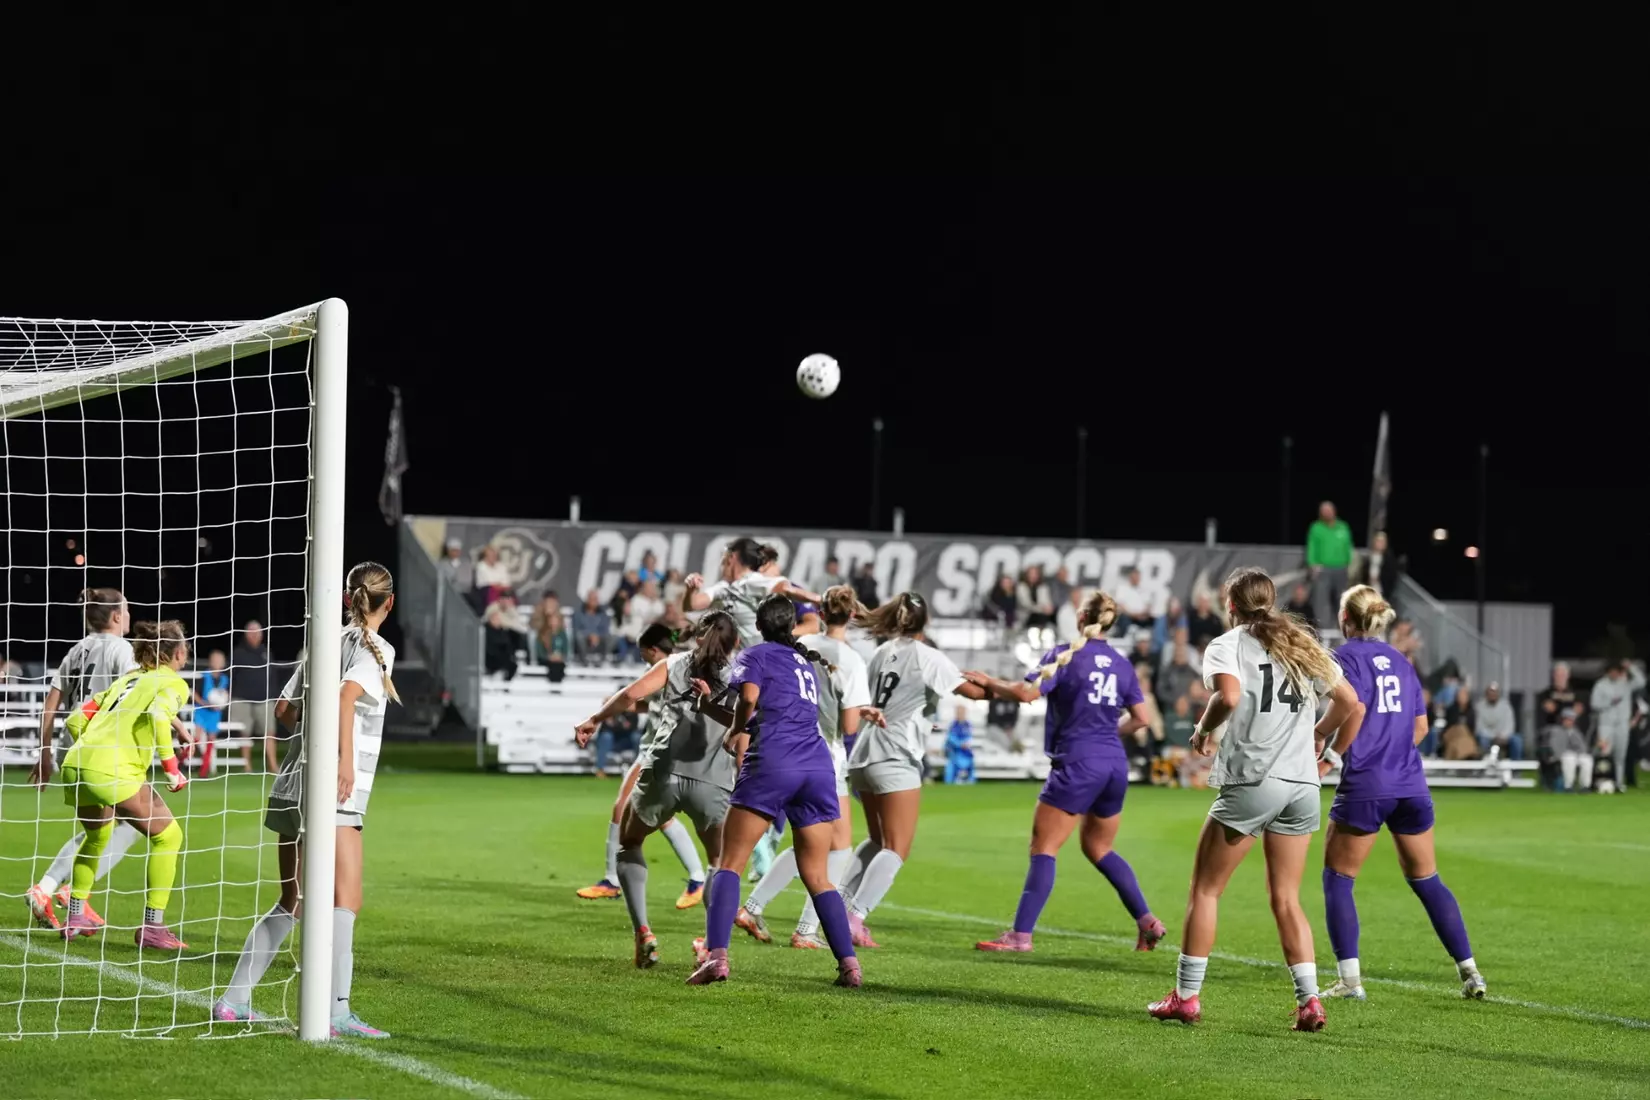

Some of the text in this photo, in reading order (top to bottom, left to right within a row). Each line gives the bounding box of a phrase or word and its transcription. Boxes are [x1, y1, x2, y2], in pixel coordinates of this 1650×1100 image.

[794, 668, 818, 705] 13
[875, 671, 901, 709] 18
[1088, 671, 1118, 706] 34
[1258, 663, 1304, 713] 14
[1376, 675, 1402, 713] 12
